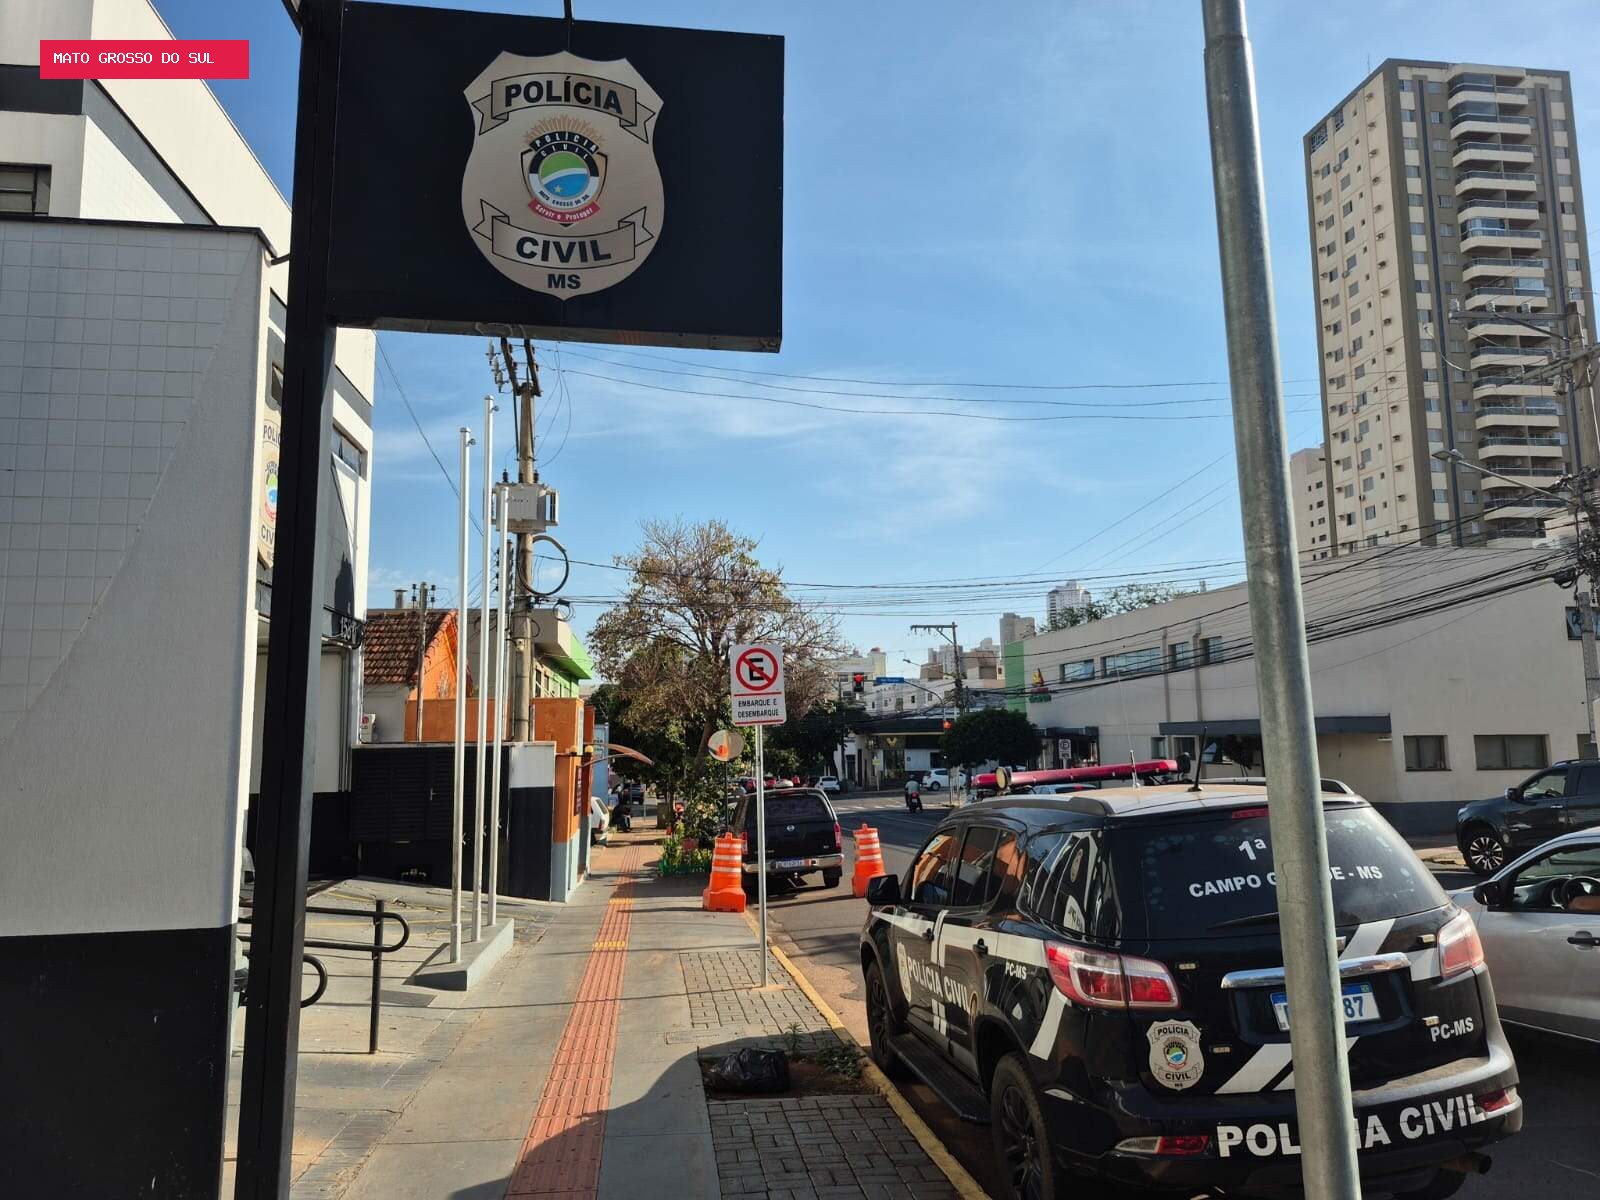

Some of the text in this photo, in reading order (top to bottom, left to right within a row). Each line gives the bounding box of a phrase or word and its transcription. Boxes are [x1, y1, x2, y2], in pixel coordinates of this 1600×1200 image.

[504, 75, 623, 115] POLÍCIA
[541, 143, 588, 159] CIVIL
[516, 236, 611, 263] CIVIL
[547, 274, 581, 289] MS
[261, 524, 275, 545] CIV
[737, 708, 779, 718] DESEMBARQUE
[738, 698, 777, 708] EMBARQUE E
[1189, 873, 1261, 898] CAMPO
[1355, 865, 1383, 879] MS
[1005, 961, 1027, 980] PC-MS
[907, 955, 944, 998] POLÍCIA
[943, 975, 971, 1015] CIVIL
[1430, 1017, 1474, 1042] PC-MS
[1165, 1072, 1191, 1080] CIVIL
[1217, 1093, 1485, 1157] POLIA CIVIL
